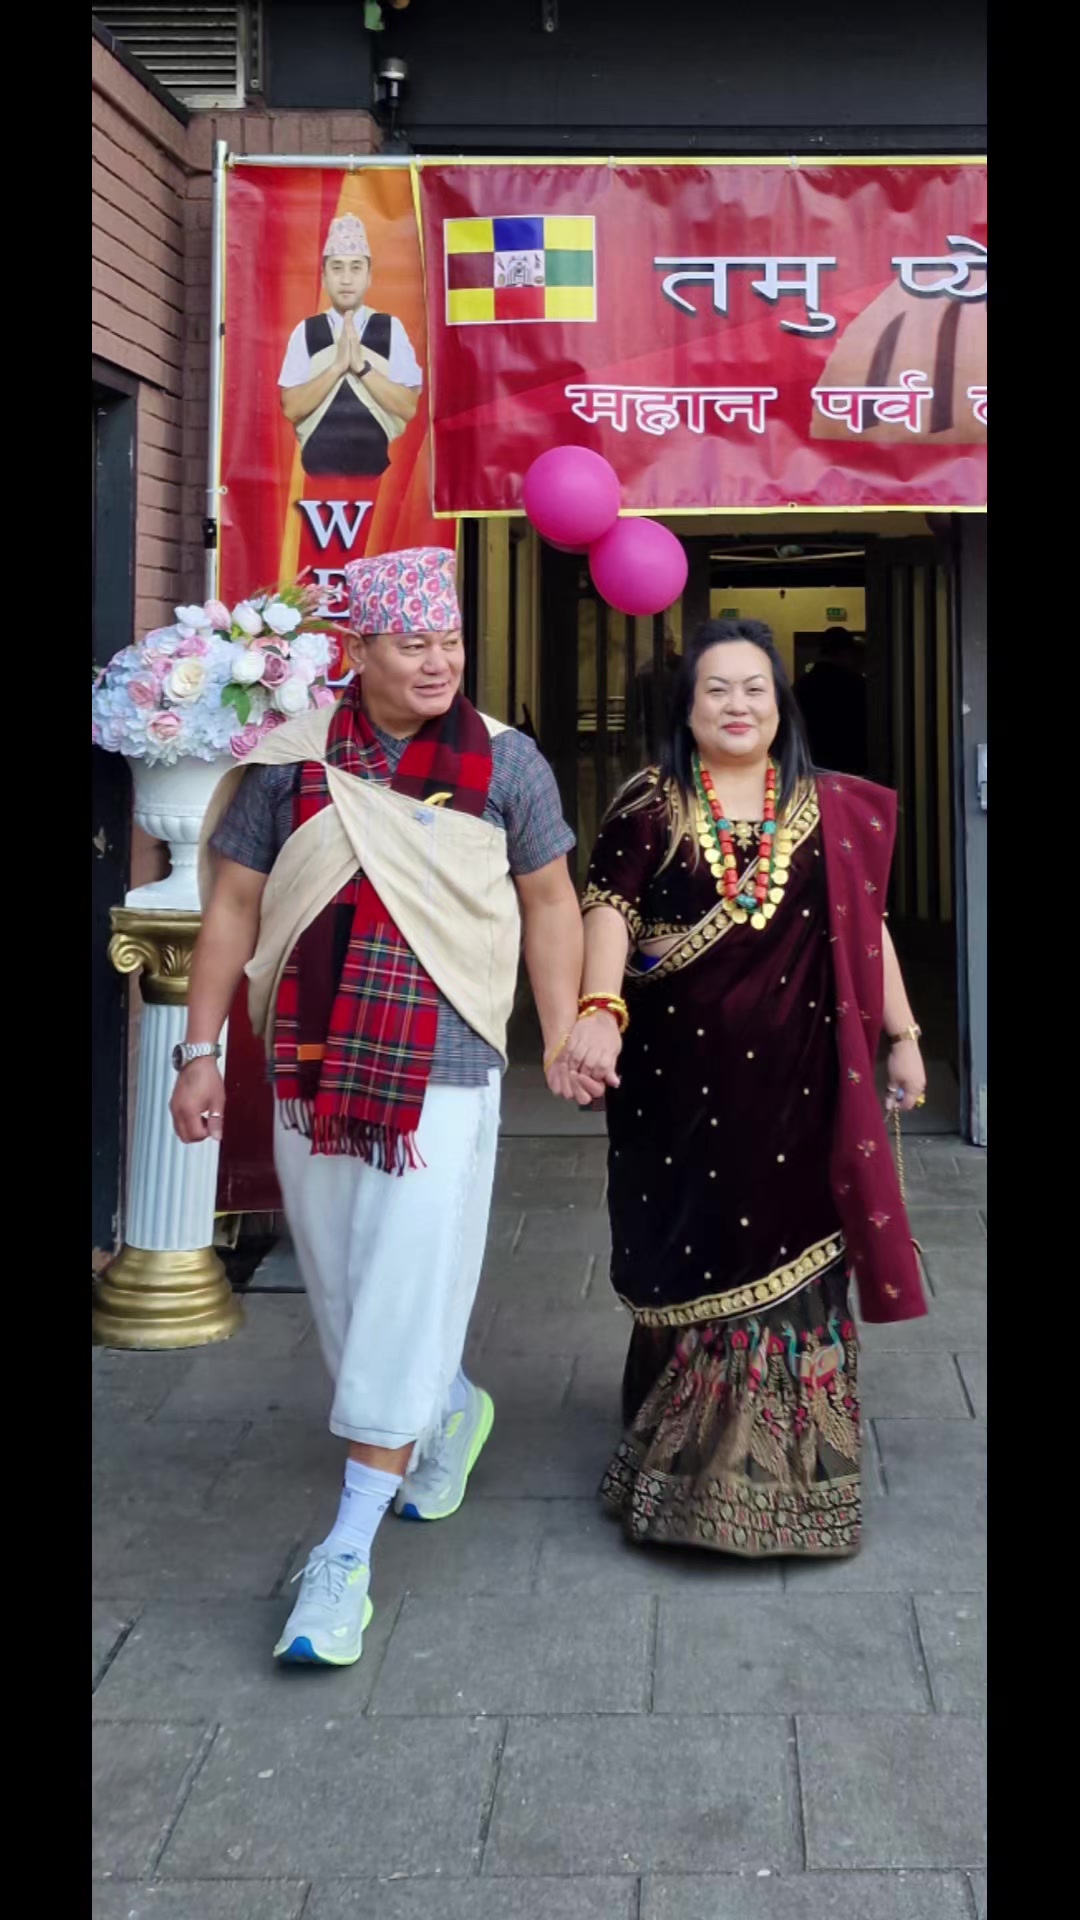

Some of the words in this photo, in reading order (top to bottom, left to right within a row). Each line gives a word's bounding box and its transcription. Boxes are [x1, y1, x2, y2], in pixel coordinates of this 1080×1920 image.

[654, 255, 838, 335] तमु
[565, 385, 778, 435] महान
[811, 369, 934, 433] पर्व
